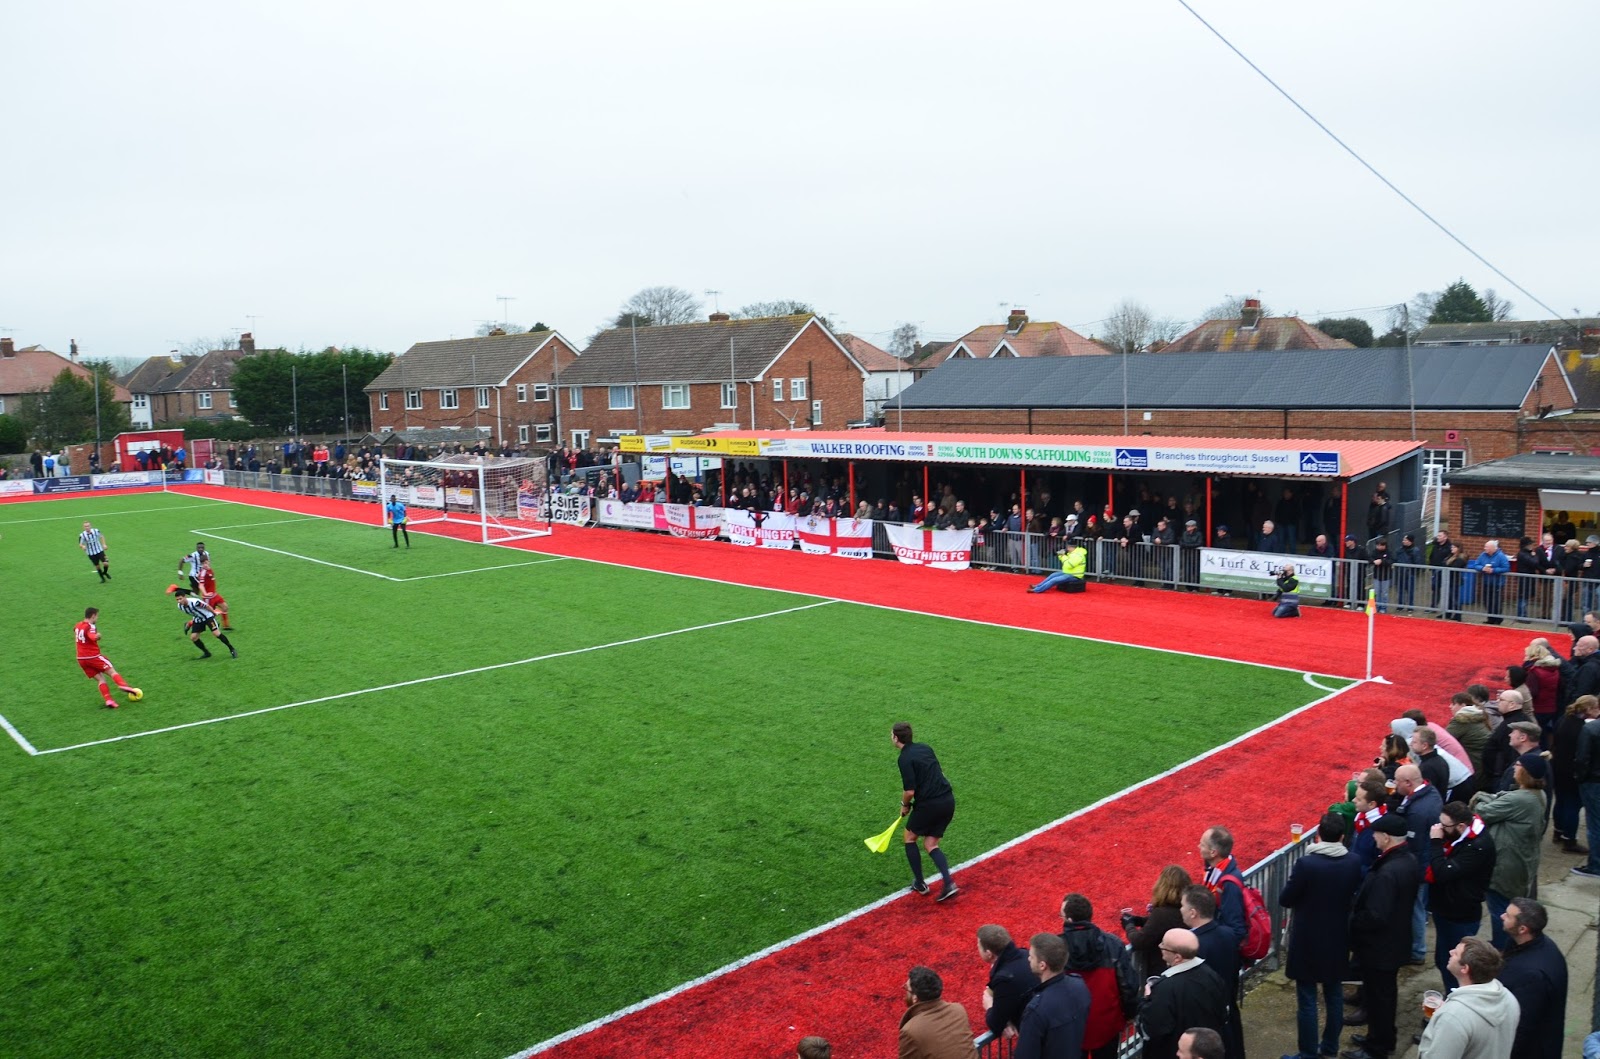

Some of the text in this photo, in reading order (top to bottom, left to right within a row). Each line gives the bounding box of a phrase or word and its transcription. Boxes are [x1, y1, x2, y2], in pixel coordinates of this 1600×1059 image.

[811, 443, 852, 454] WALKER
[855, 444, 905, 456] ROOFING
[956, 447, 1091, 463] SOUTH DOWNS SCAFFOLDING
[1118, 458, 1131, 466] MS
[1155, 451, 1289, 464] Branches throughout Sussex!
[1302, 463, 1318, 471] MS
[780, 530, 793, 540] FC
[950, 552, 965, 561] FC
[1218, 557, 1326, 577] Turf & Tre Tech
[75, 627, 86, 644] 14
